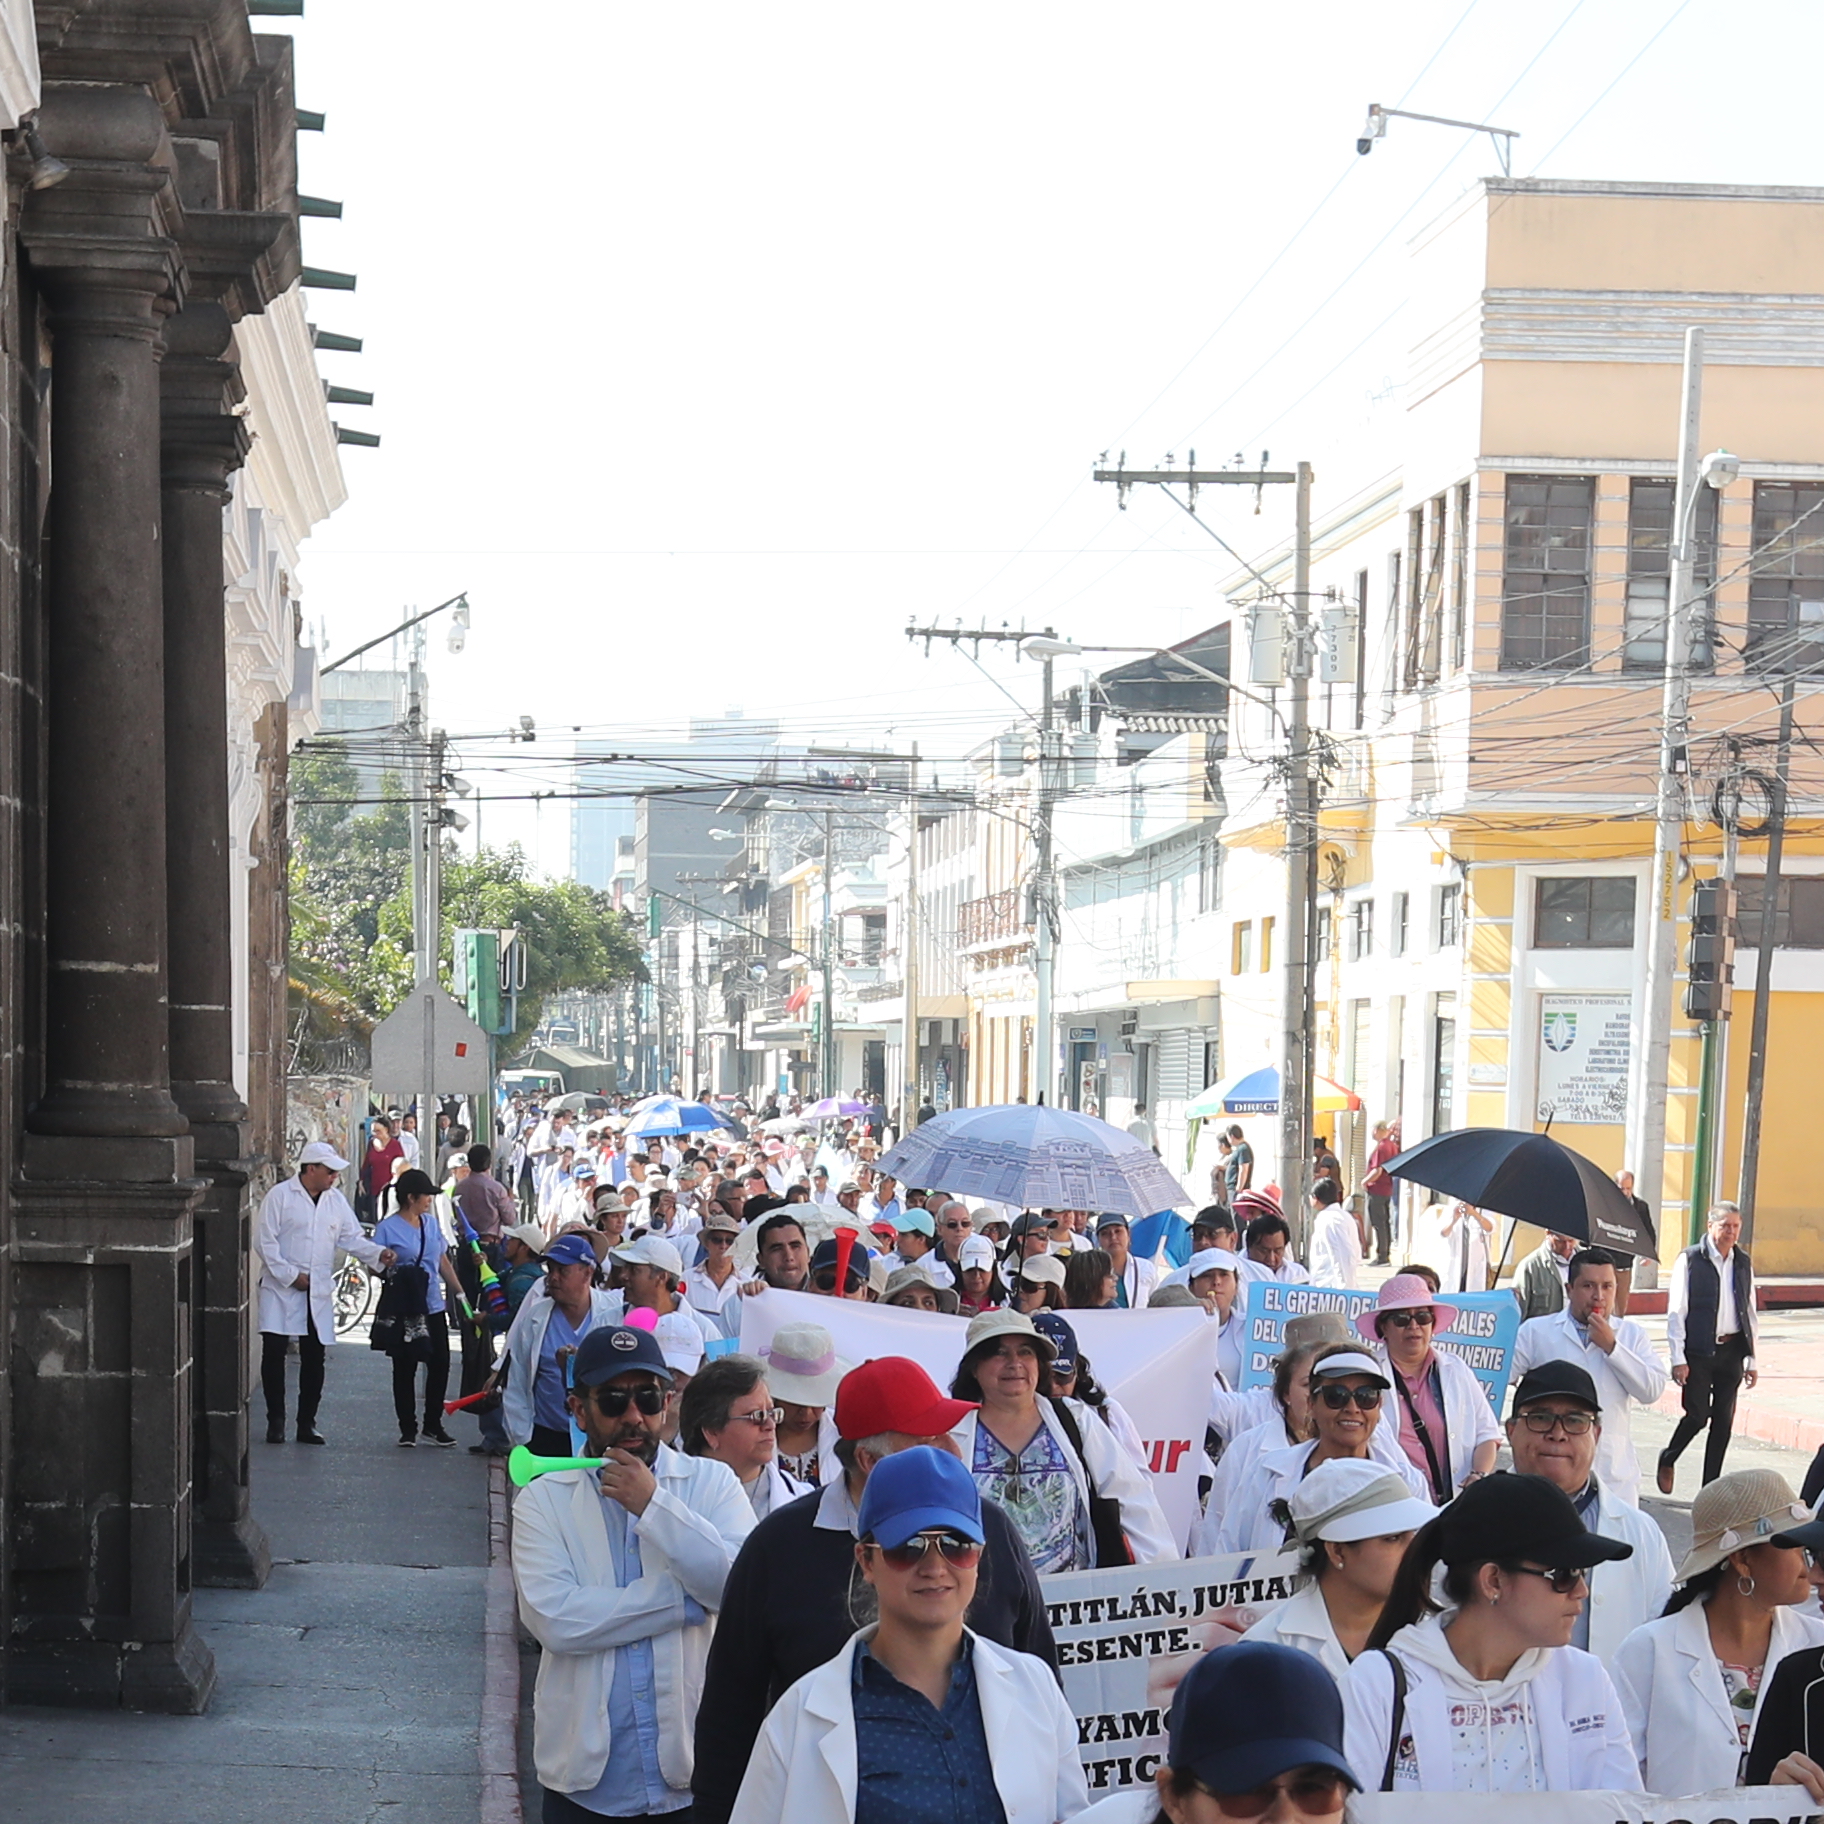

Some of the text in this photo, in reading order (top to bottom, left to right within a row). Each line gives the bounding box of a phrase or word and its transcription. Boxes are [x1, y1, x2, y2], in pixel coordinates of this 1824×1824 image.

[1663, 850, 1673, 920] 152752
[1265, 1288, 1284, 1312] EL
[1286, 1290, 1348, 1316] GREMIO
